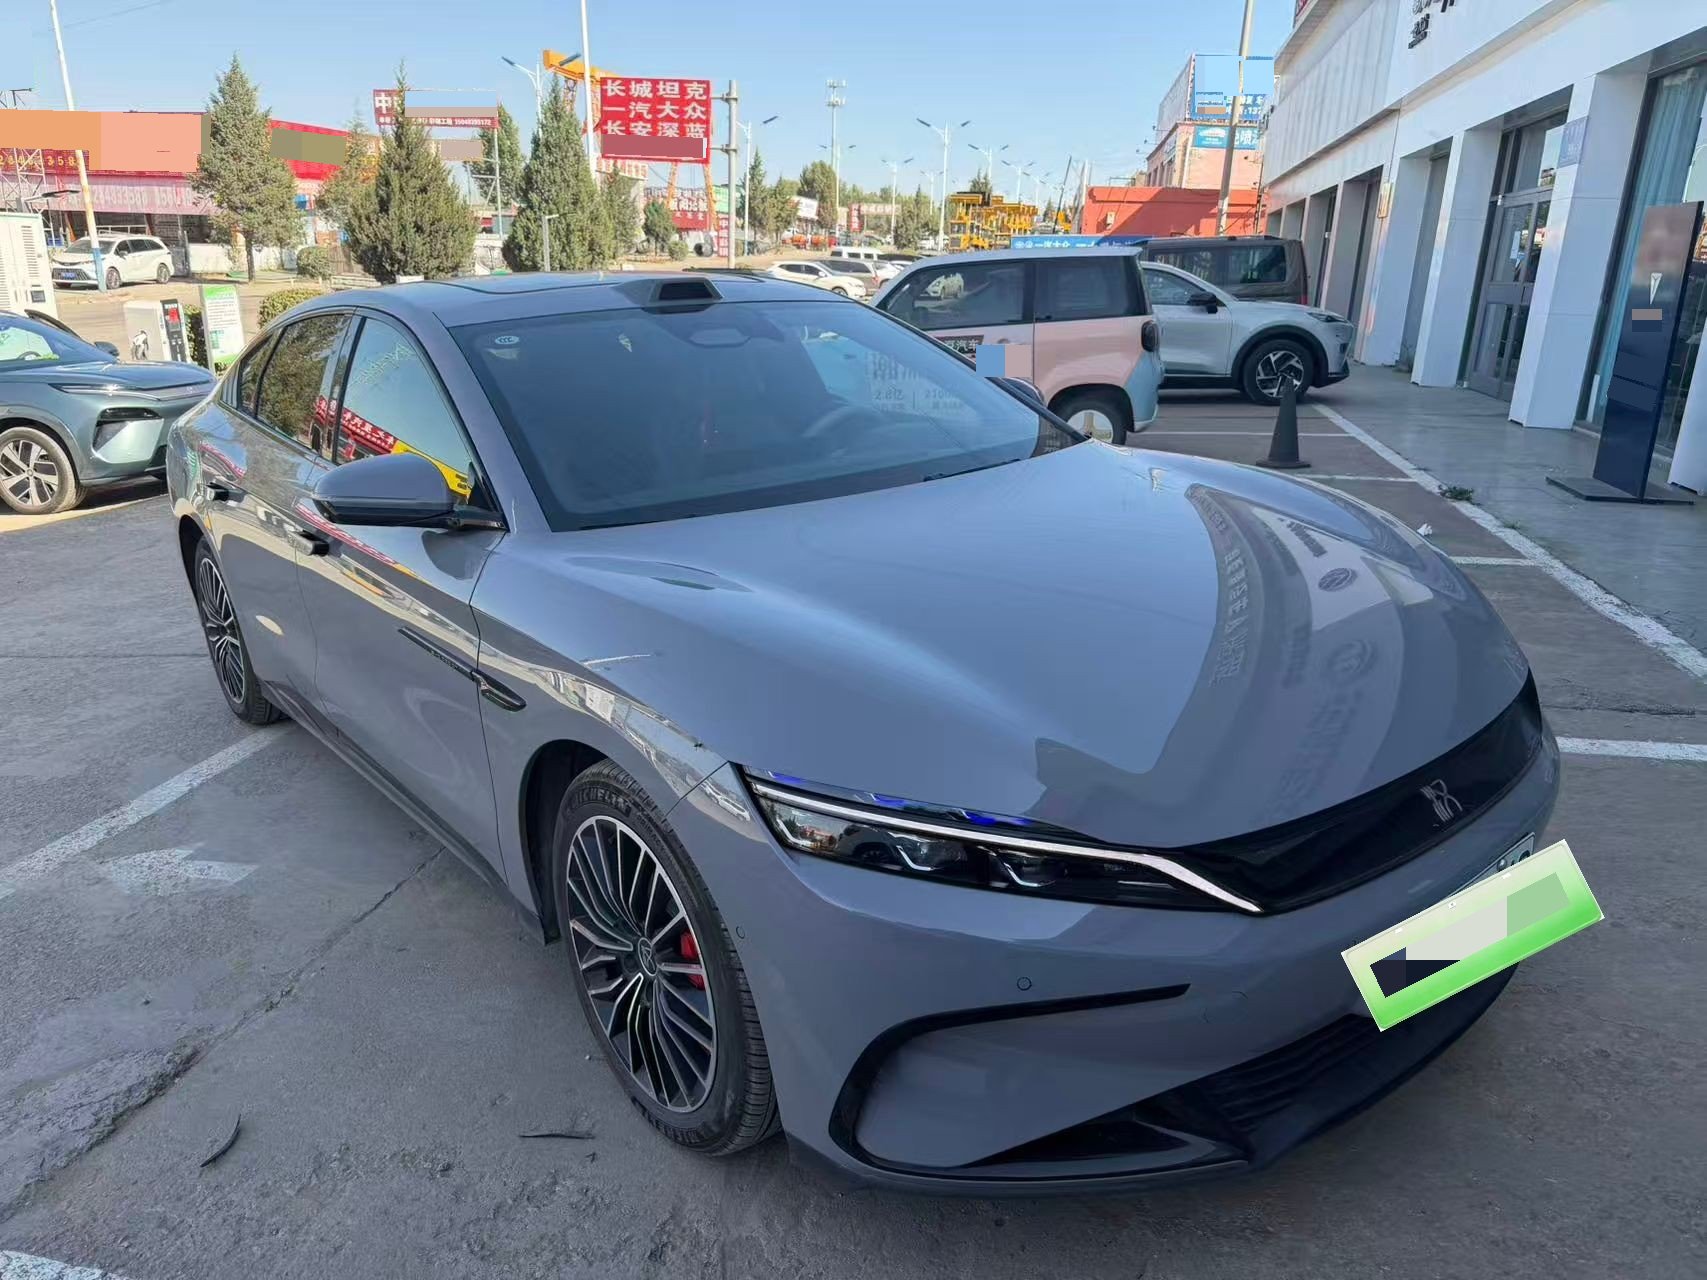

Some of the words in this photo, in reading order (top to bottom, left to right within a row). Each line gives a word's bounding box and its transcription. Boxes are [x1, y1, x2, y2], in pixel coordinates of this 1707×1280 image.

[603, 80, 707, 100] 长城坦克
[603, 101, 707, 120] 一汽大众
[603, 121, 707, 139] 长安深蓝
